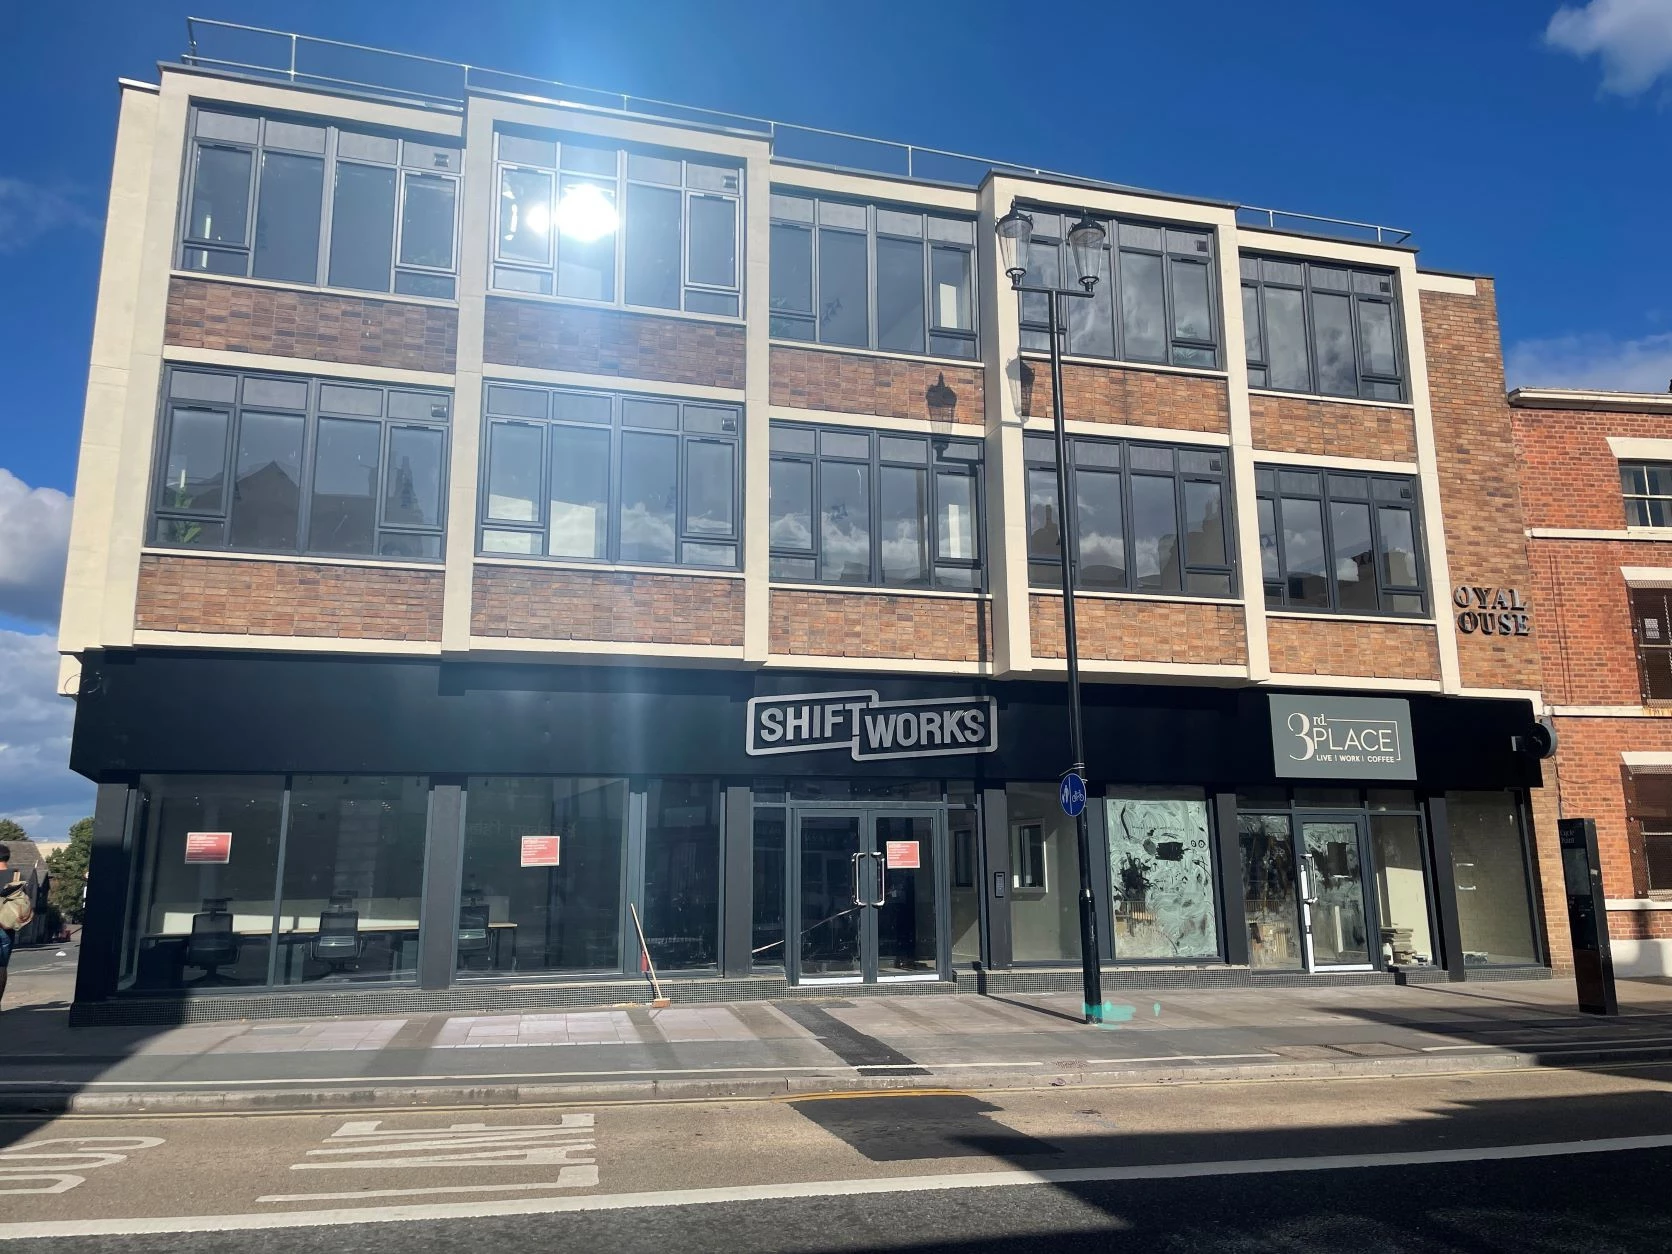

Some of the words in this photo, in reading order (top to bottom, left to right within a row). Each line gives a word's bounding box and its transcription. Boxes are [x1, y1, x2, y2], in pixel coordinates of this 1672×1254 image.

[1453, 586, 1527, 611] OYAL
[1457, 611, 1532, 636] OUSE
[760, 703, 867, 742] SHIFT
[864, 709, 986, 748] WORKS
[1313, 727, 1394, 752] PLACE
[1316, 754, 1332, 762] LIVE
[1339, 754, 1360, 763] WORK
[1367, 755, 1395, 763] COFFEE
